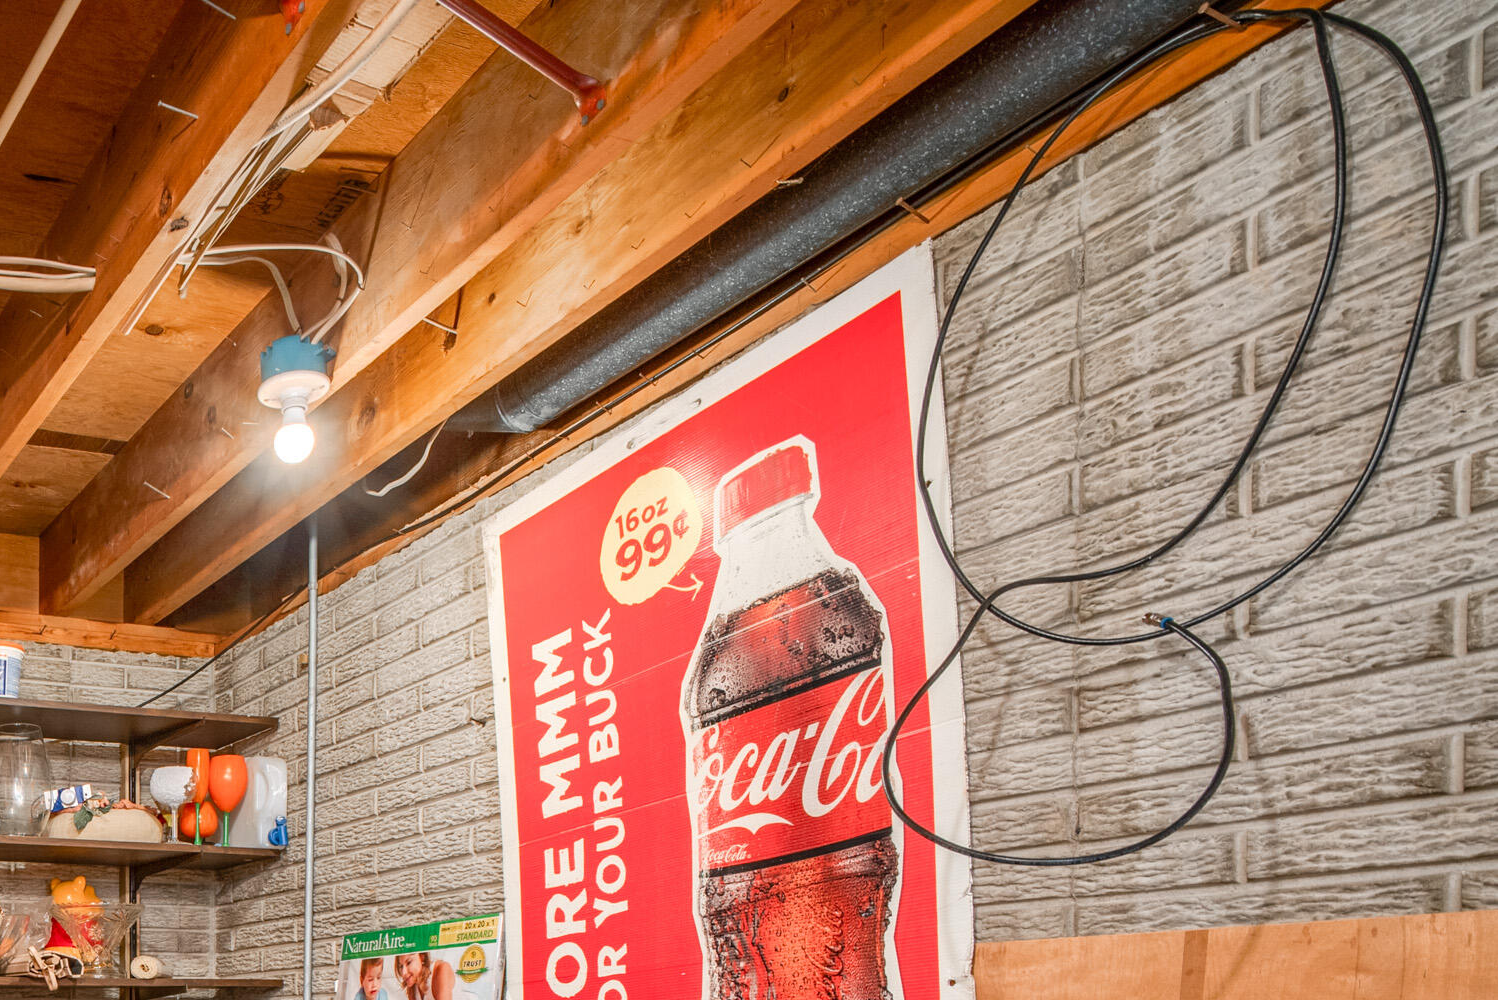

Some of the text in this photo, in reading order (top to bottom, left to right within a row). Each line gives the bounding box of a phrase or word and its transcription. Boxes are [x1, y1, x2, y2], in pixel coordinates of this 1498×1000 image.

[615, 496, 668, 539] 16oz
[582, 607, 621, 763] BUCK
[532, 628, 584, 819] MMM
[592, 775, 628, 929] YOUR
[344, 932, 405, 955] NaturalAire
[456, 929, 494, 941] STANDARD
[463, 959, 482, 967] TRUST
